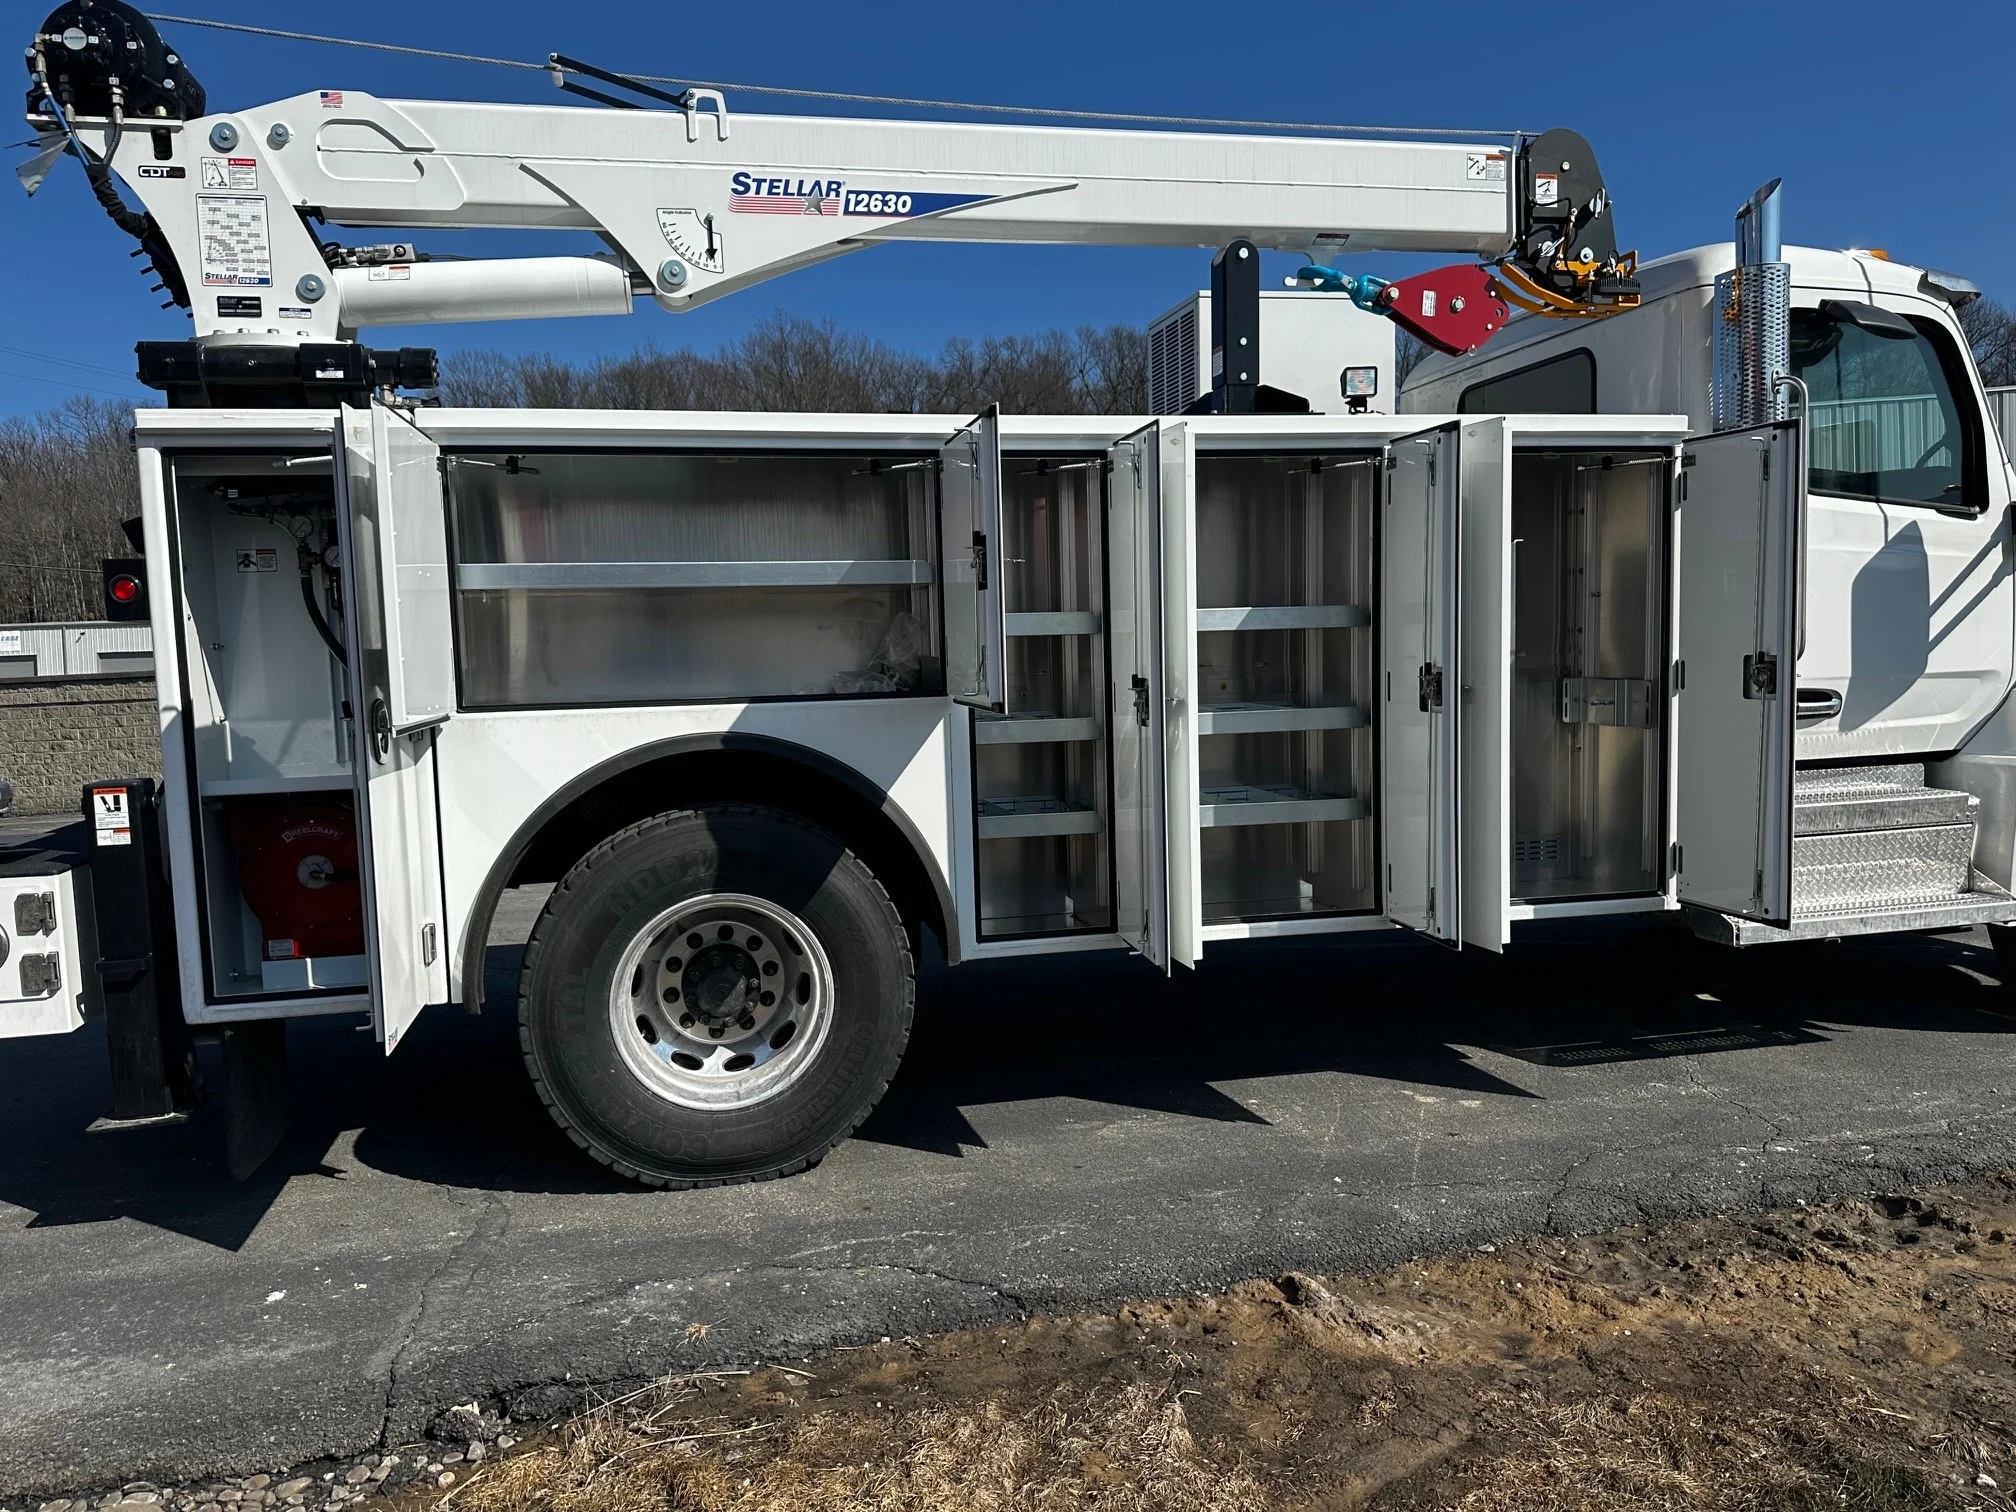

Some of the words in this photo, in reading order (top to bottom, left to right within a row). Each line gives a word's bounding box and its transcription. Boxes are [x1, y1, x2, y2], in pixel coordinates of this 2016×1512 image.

[139, 166, 170, 178] CDT
[731, 171, 842, 198] STELLAR
[848, 193, 912, 214] 12630
[205, 272, 238, 280] STELLAR
[291, 826, 339, 838] REELCRAFT
